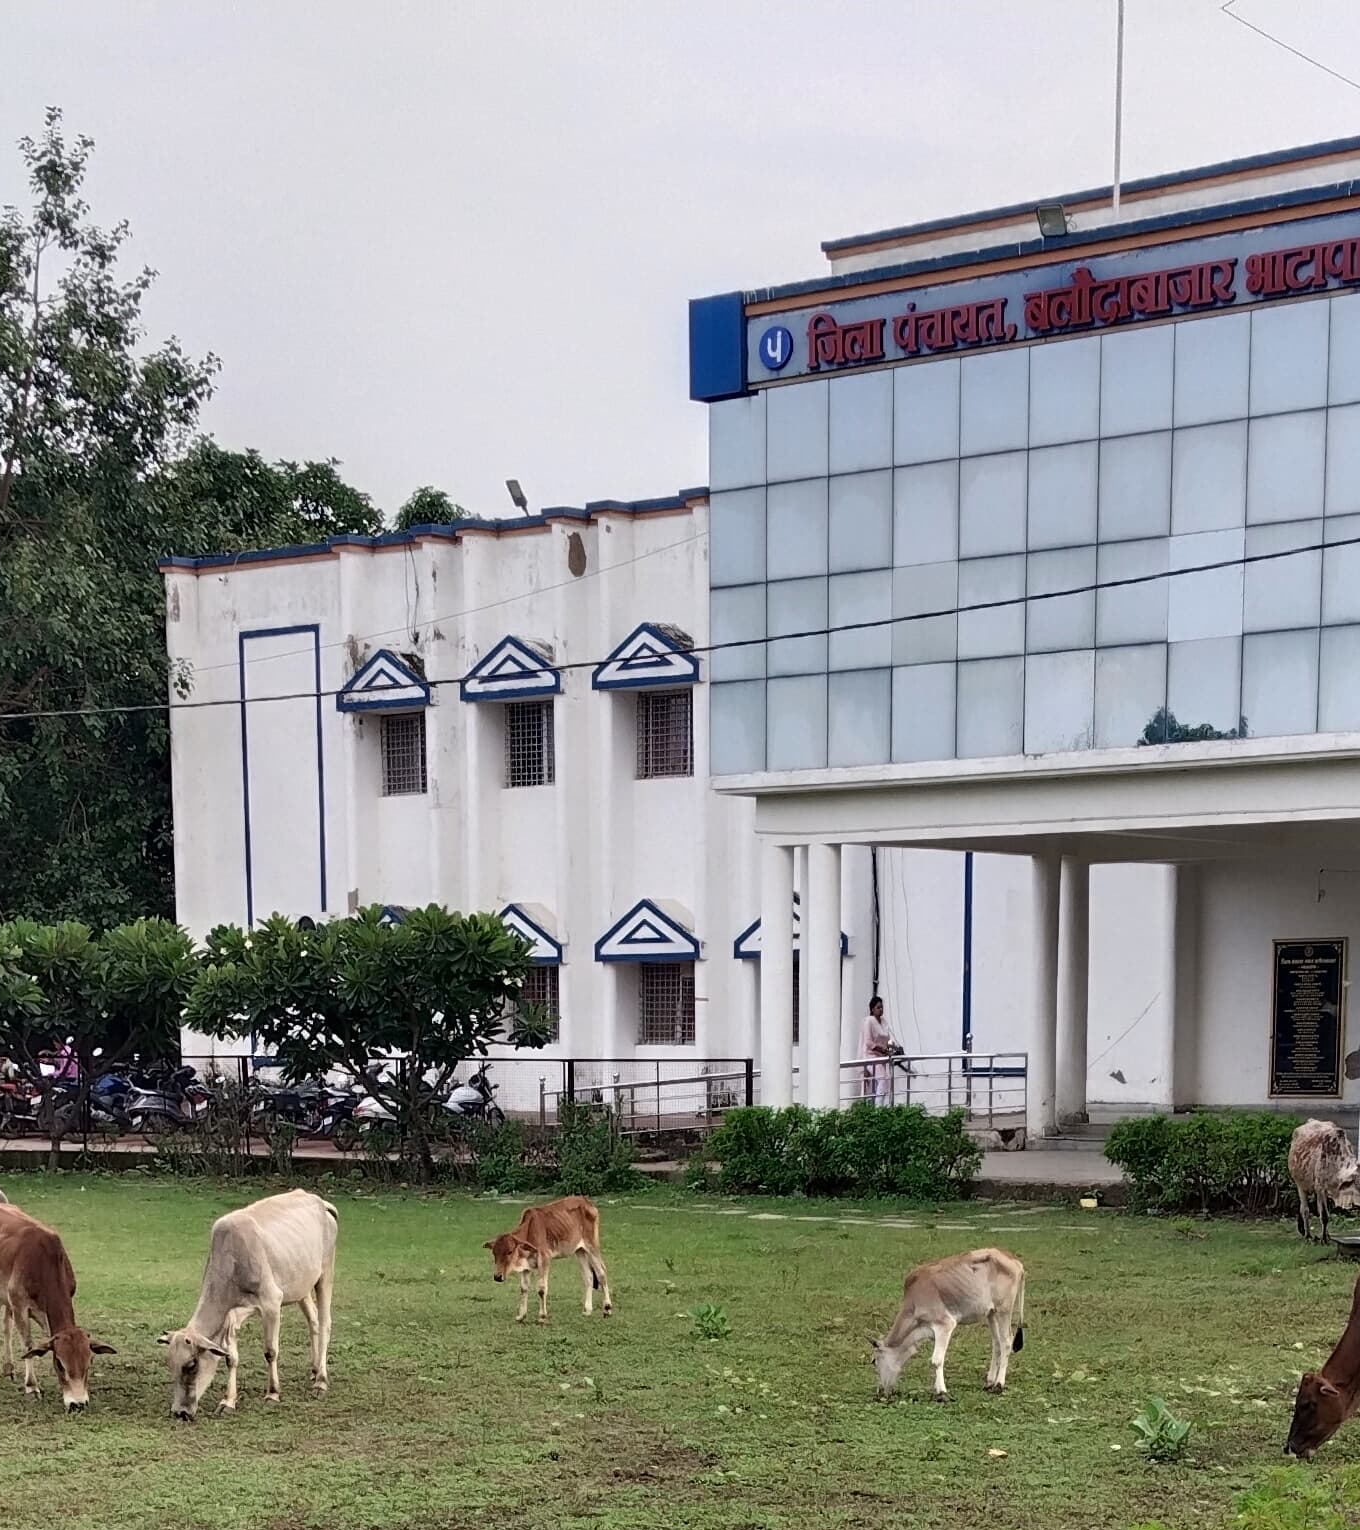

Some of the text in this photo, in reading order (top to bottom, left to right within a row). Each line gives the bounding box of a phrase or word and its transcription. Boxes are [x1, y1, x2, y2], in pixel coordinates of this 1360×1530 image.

[807, 313, 884, 369] जिला
[892, 297, 1016, 352] पंचायत,
[1024, 258, 1238, 331] बलौदाबाजार
